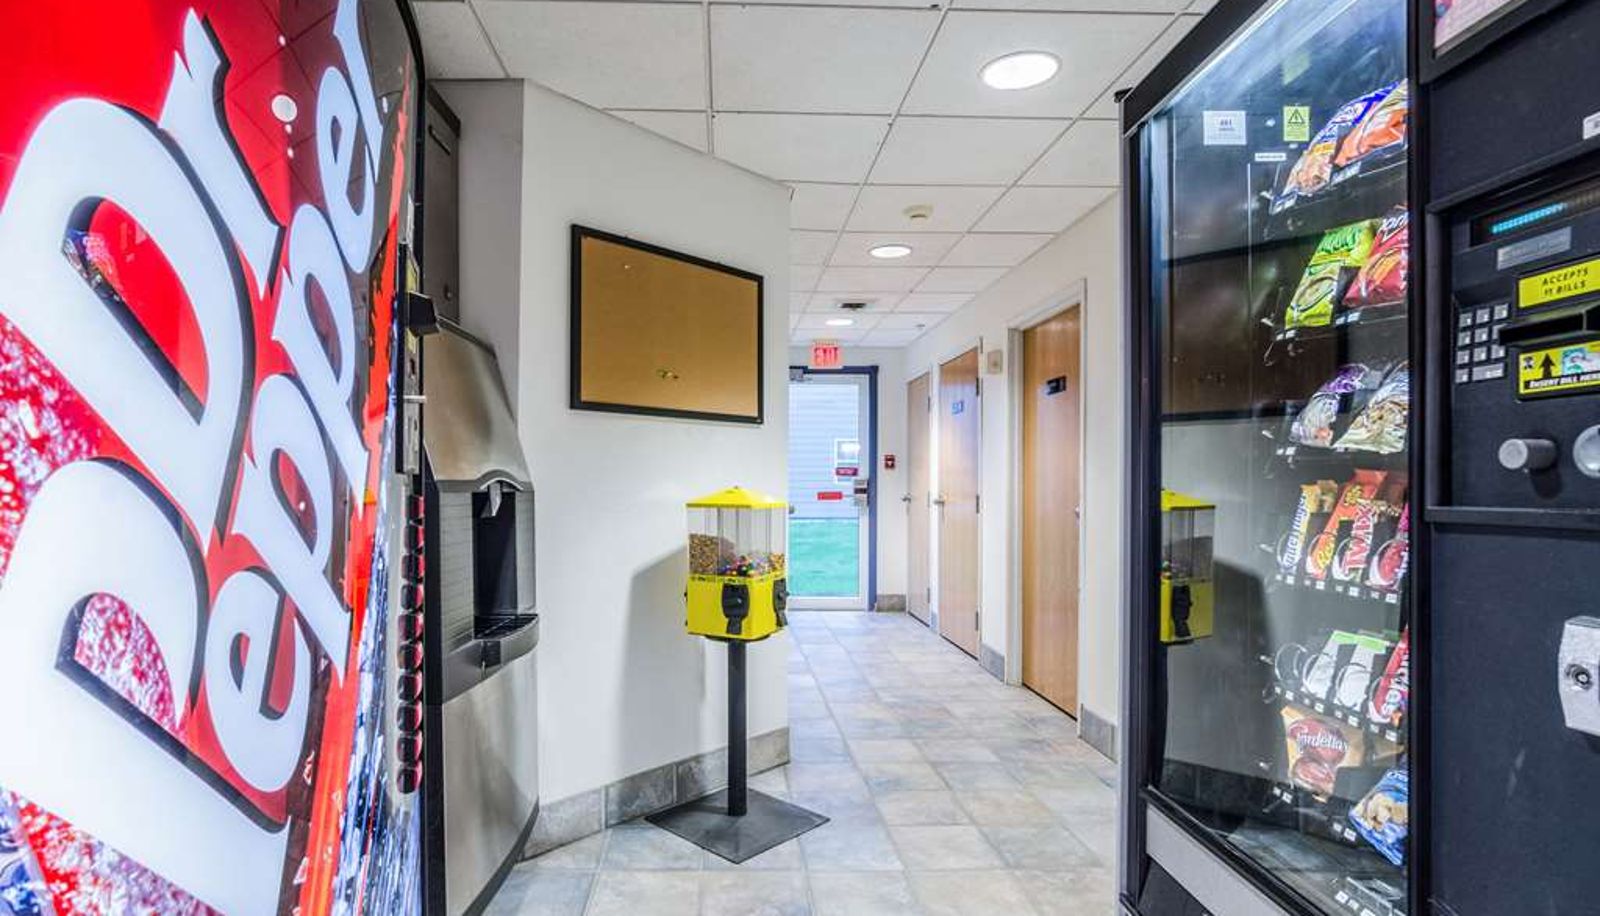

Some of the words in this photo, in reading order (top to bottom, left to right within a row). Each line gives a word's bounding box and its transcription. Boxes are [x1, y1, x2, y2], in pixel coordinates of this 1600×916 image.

[0, 8, 282, 552] Dr
[1542, 267, 1589, 285] ACCEPTS
[1556, 280, 1586, 294] BILLS
[814, 347, 838, 366] EXIT
